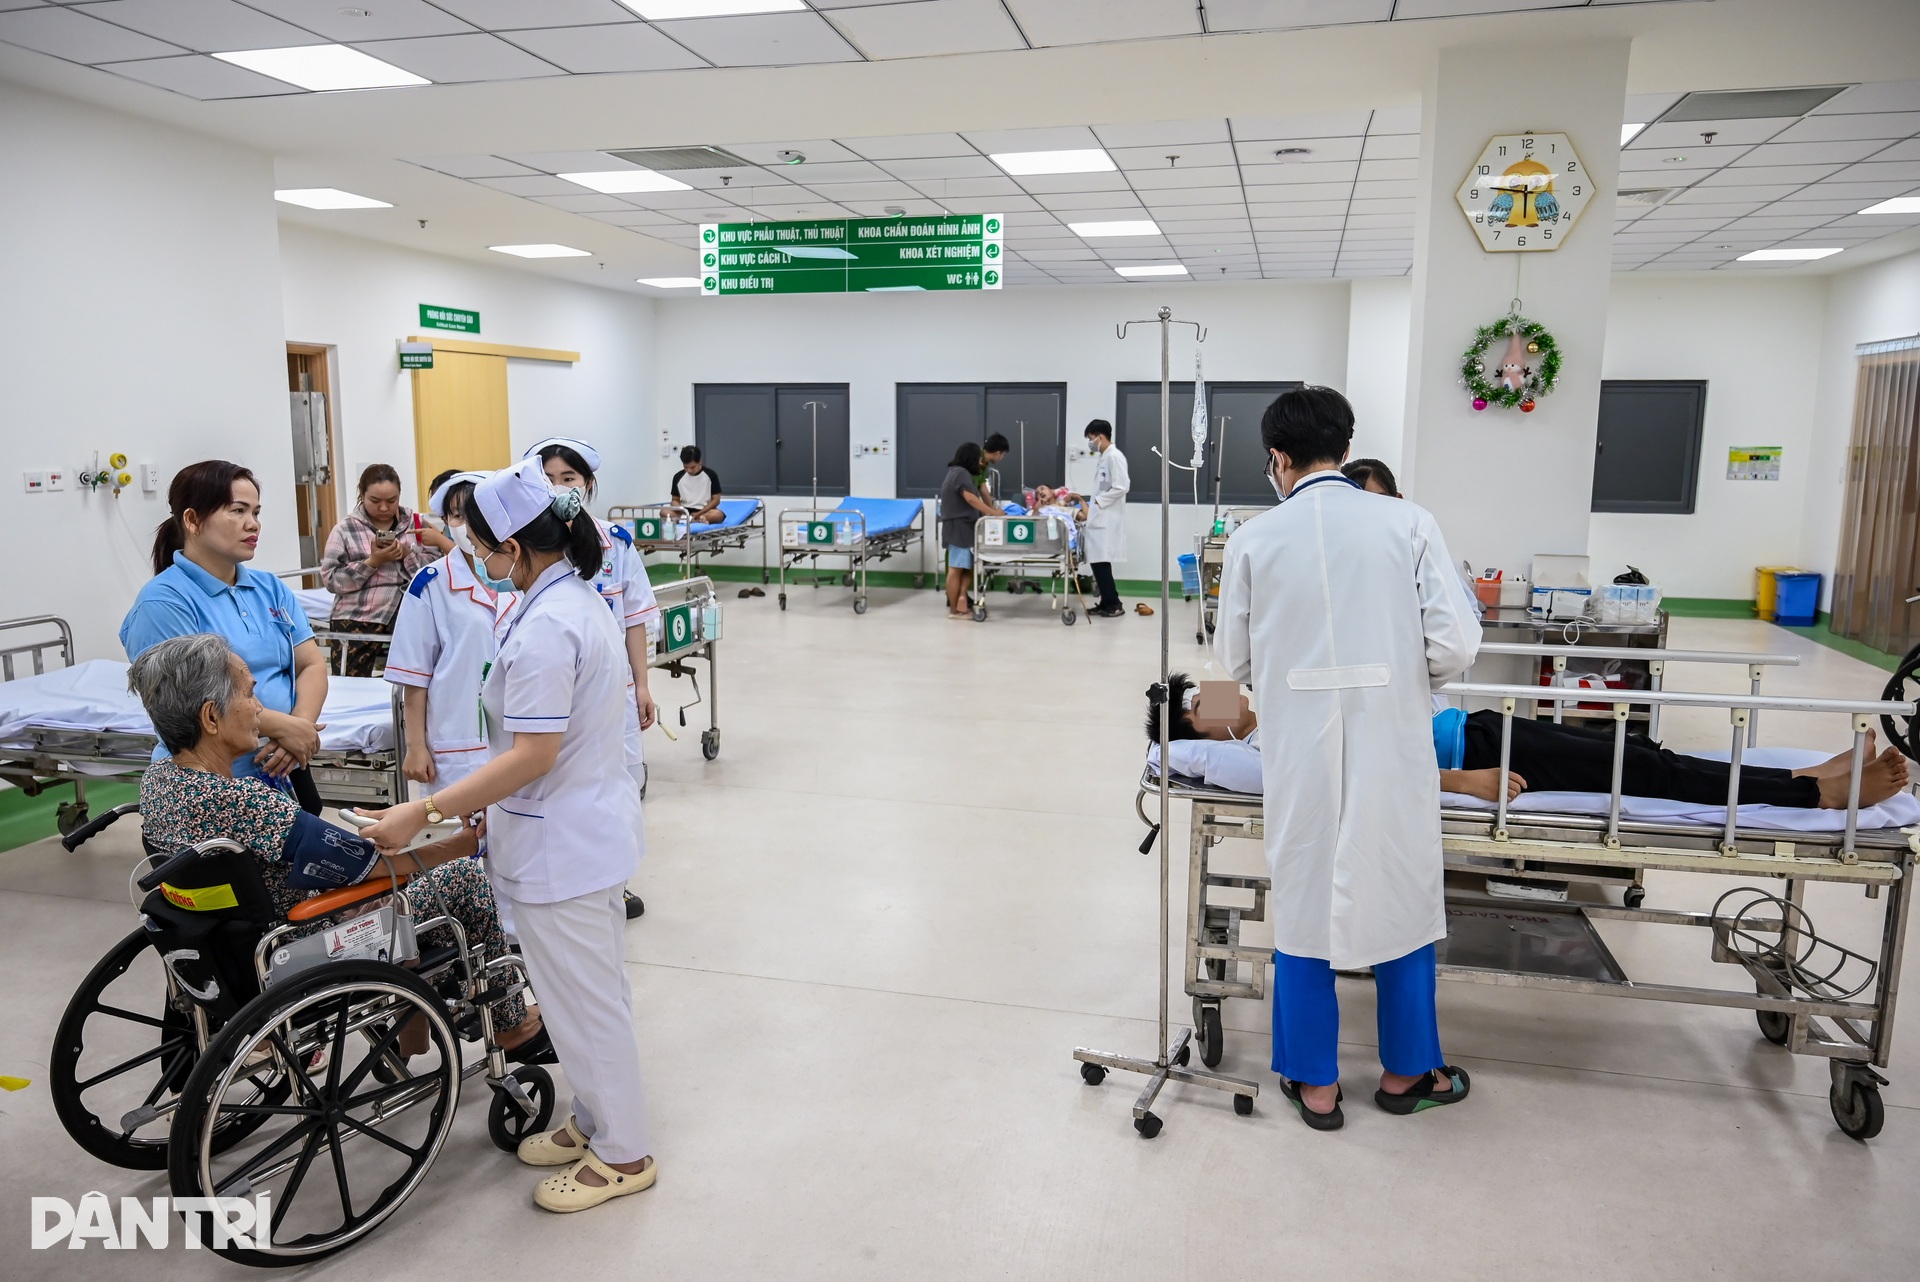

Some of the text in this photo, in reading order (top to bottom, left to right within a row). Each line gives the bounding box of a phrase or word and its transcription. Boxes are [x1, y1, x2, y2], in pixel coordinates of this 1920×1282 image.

[1521, 138, 1534, 149] 12
[1551, 144, 1555, 154] 1
[1499, 146, 1506, 156] 11
[1477, 165, 1490, 175] 10
[1567, 161, 1576, 172] 2
[1470, 189, 1479, 199] 9
[1572, 185, 1581, 196] 3
[1475, 212, 1484, 223] 8
[1562, 211, 1571, 221] 4
[720, 231, 736, 242] KHU
[737, 229, 753, 243] VỰC
[753, 226, 774, 241] PHẪU
[804, 224, 819, 239] THỦ
[820, 225, 844, 241] THUẬT
[858, 227, 882, 238] KHOA
[910, 223, 935, 237] ĐOÁN
[937, 222, 959, 236] HÌNH
[961, 219, 981, 235] ẢNH
[1493, 230, 1501, 240] 7
[1543, 229, 1552, 240] 5
[1517, 236, 1526, 246] 6
[900, 244, 980, 260] KHOA XÉT NGHIỆM
[721, 254, 738, 265] KHU
[739, 252, 756, 267] VỰC
[757, 251, 780, 264] CÁCH
[721, 278, 738, 290] KHU
[760, 277, 774, 291] TRỊ
[946, 273, 963, 285] WC
[818, 528, 823, 537] 2
[1018, 527, 1023, 537] 3
[676, 620, 682, 636] 6
